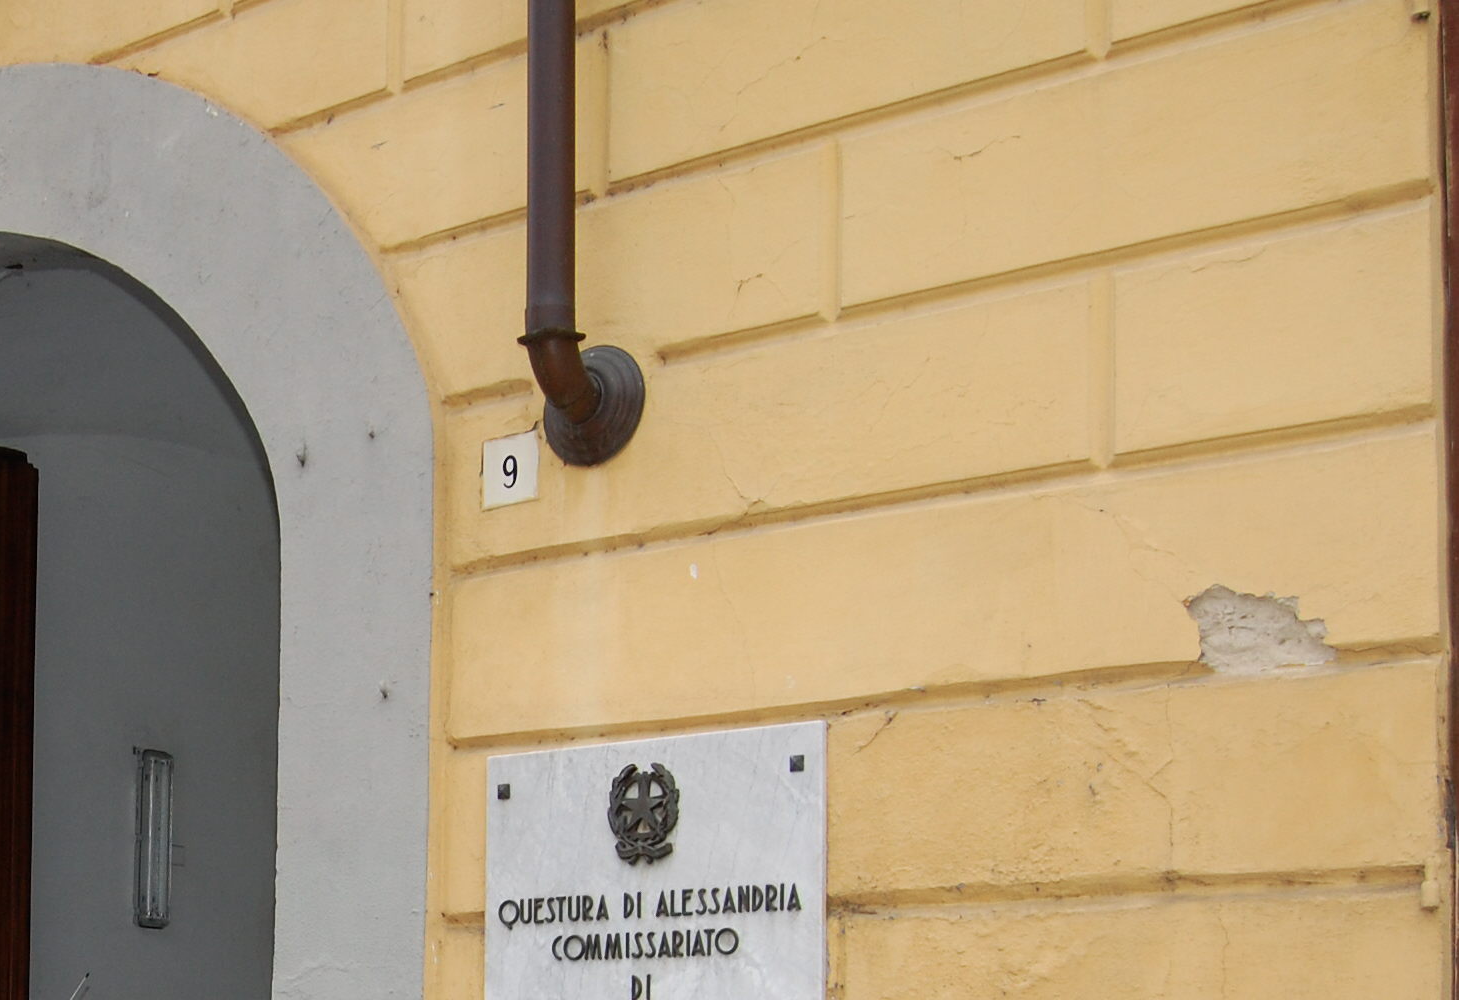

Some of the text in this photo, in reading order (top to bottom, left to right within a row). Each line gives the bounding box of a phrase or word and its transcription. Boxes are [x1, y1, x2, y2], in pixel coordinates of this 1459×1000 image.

[502, 455, 518, 488] 9
[498, 883, 802, 930] QUESTURA DI ALESSANDRIA
[552, 928, 739, 962] COMMISSARIATO
[631, 974, 651, 1000] DI
